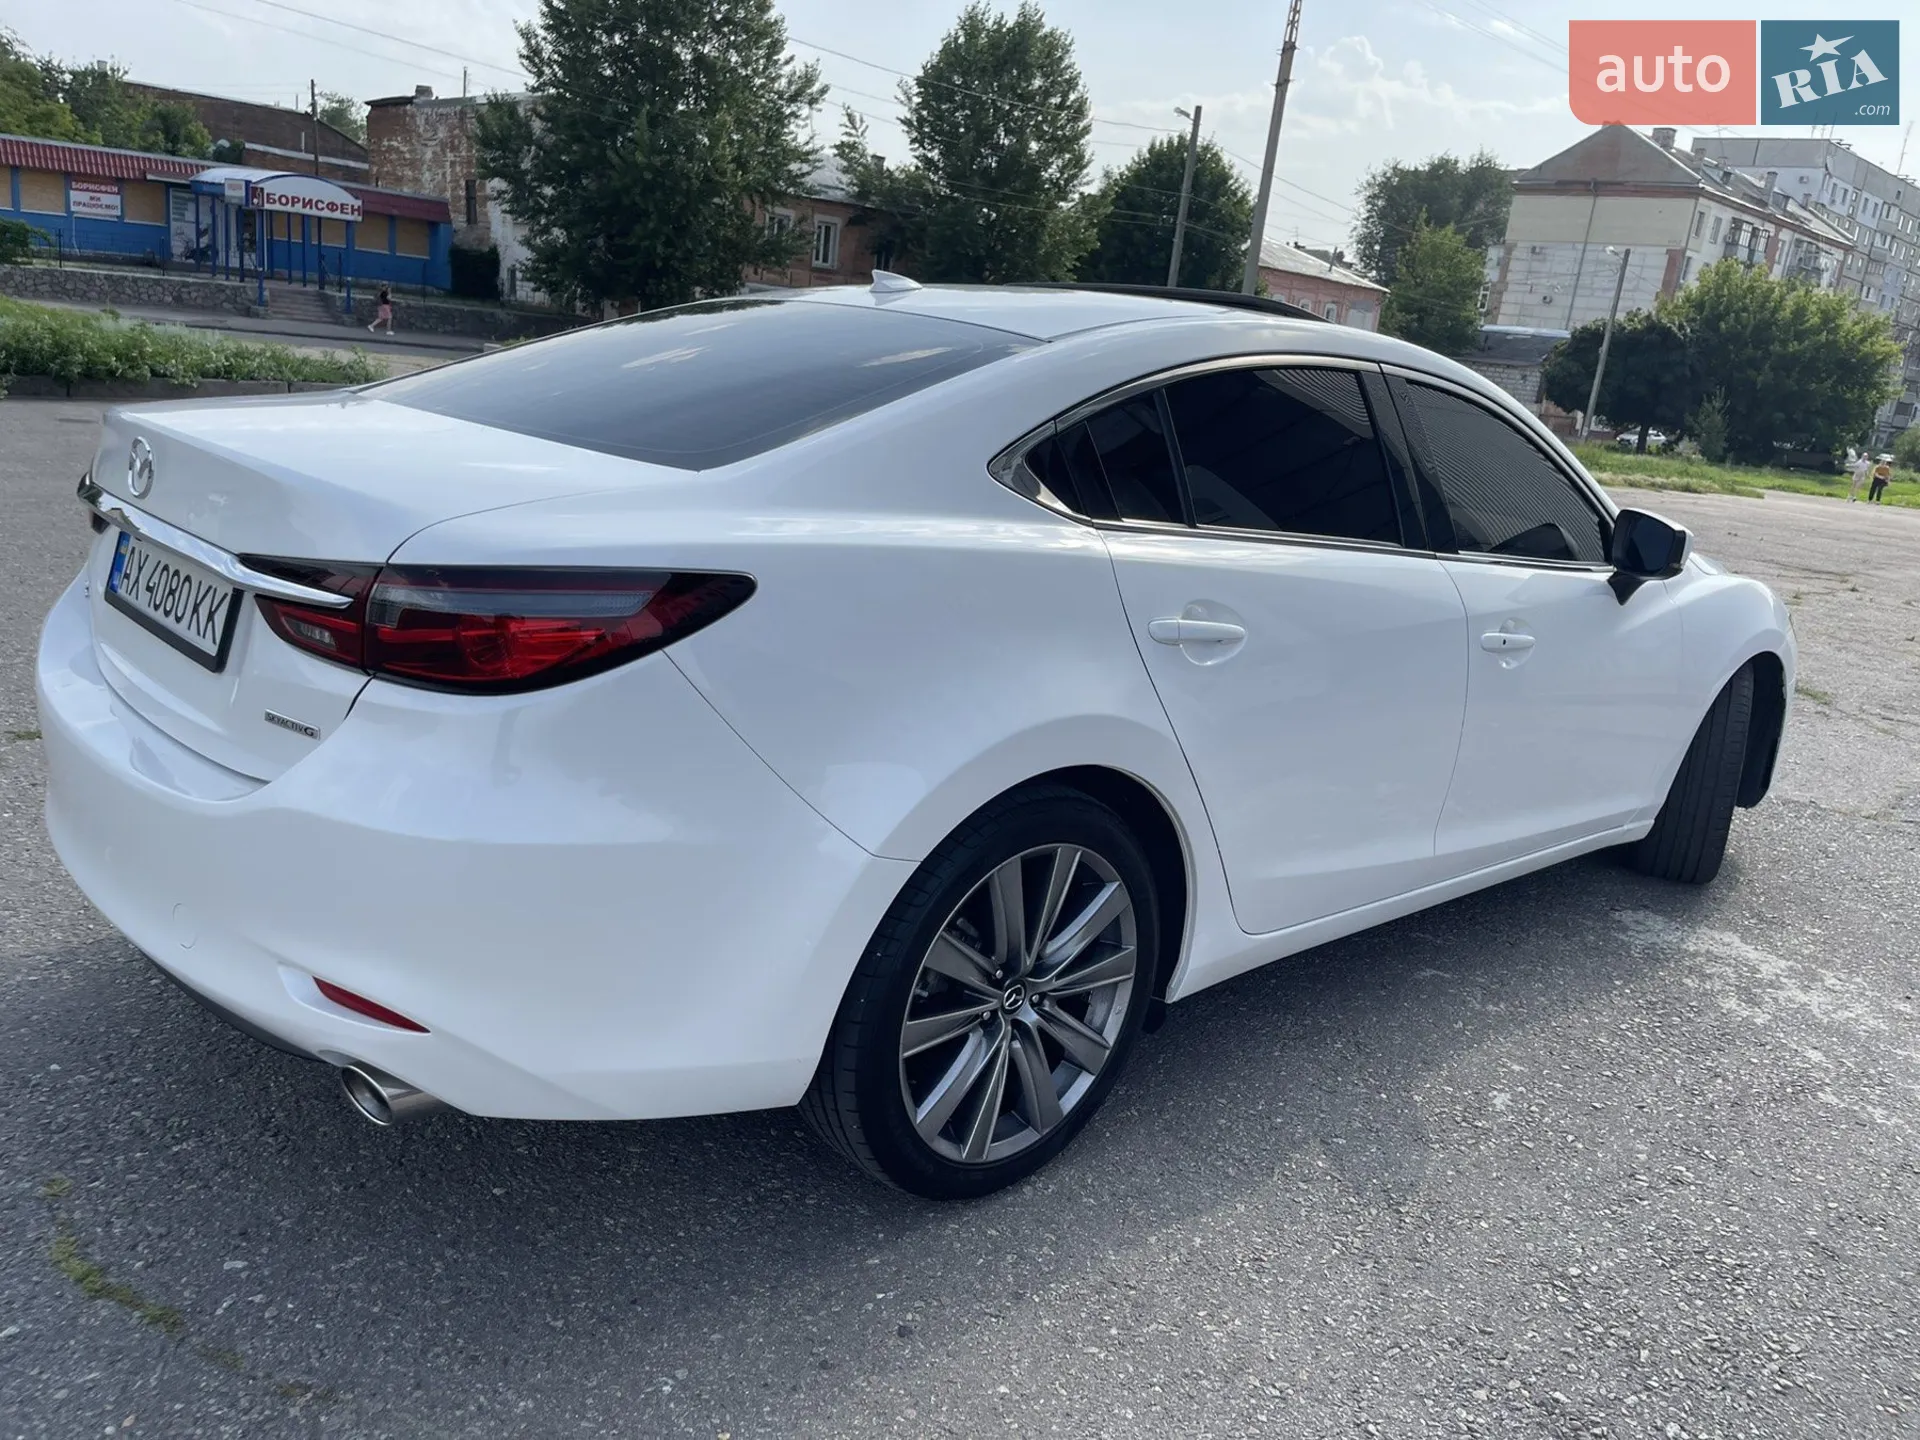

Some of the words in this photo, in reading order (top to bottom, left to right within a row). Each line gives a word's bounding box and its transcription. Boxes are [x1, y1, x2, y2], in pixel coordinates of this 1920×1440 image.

[71, 181, 118, 193] БОРИСФЕН
[265, 192, 362, 217] БОРИСФЕН
[120, 546, 150, 601] AX
[145, 560, 192, 625] 4080
[187, 580, 229, 646] KK
